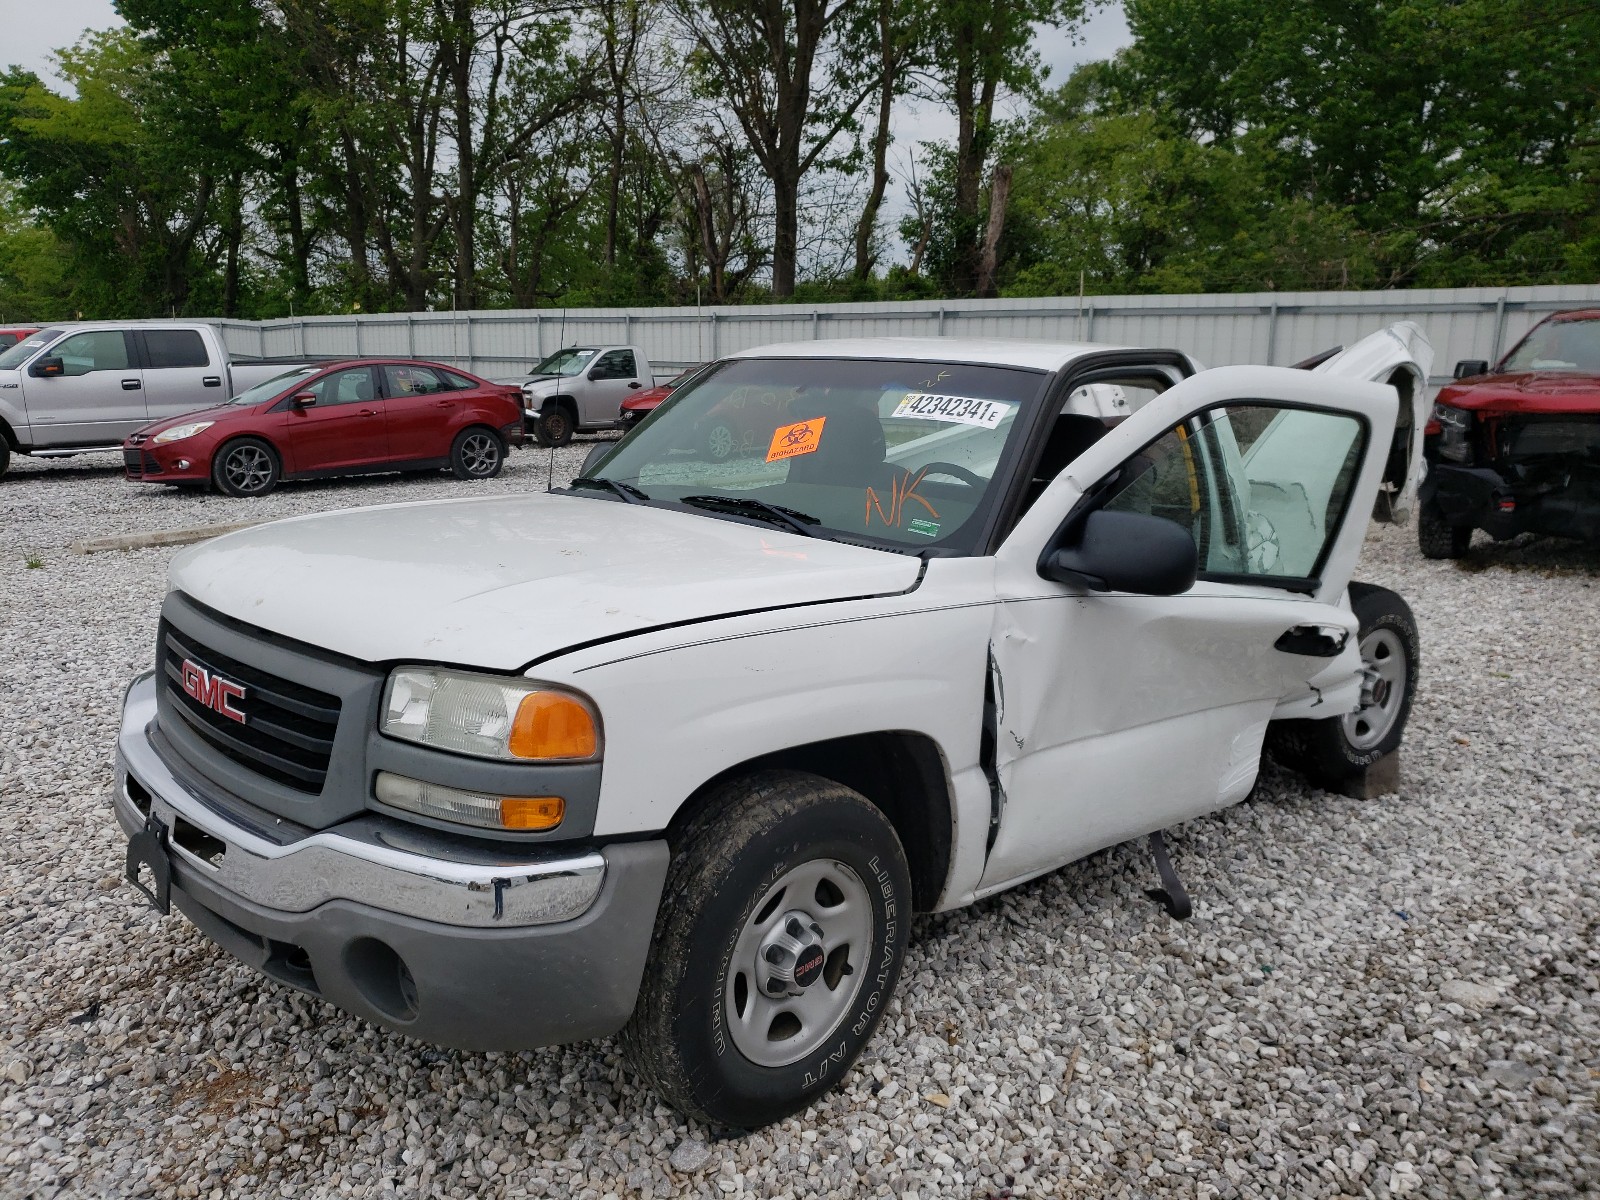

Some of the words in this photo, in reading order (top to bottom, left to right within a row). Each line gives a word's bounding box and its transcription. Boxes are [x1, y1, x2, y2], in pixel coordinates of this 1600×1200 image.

[909, 395, 993, 420] 42342341
[987, 411, 999, 422] E
[770, 443, 815, 459] BIOHAZARD
[865, 465, 941, 528] NK
[182, 659, 246, 725] GMC
[795, 954, 823, 977] GMC
[852, 856, 898, 1036] LIBERATOR
[802, 1041, 847, 1090] A/T
